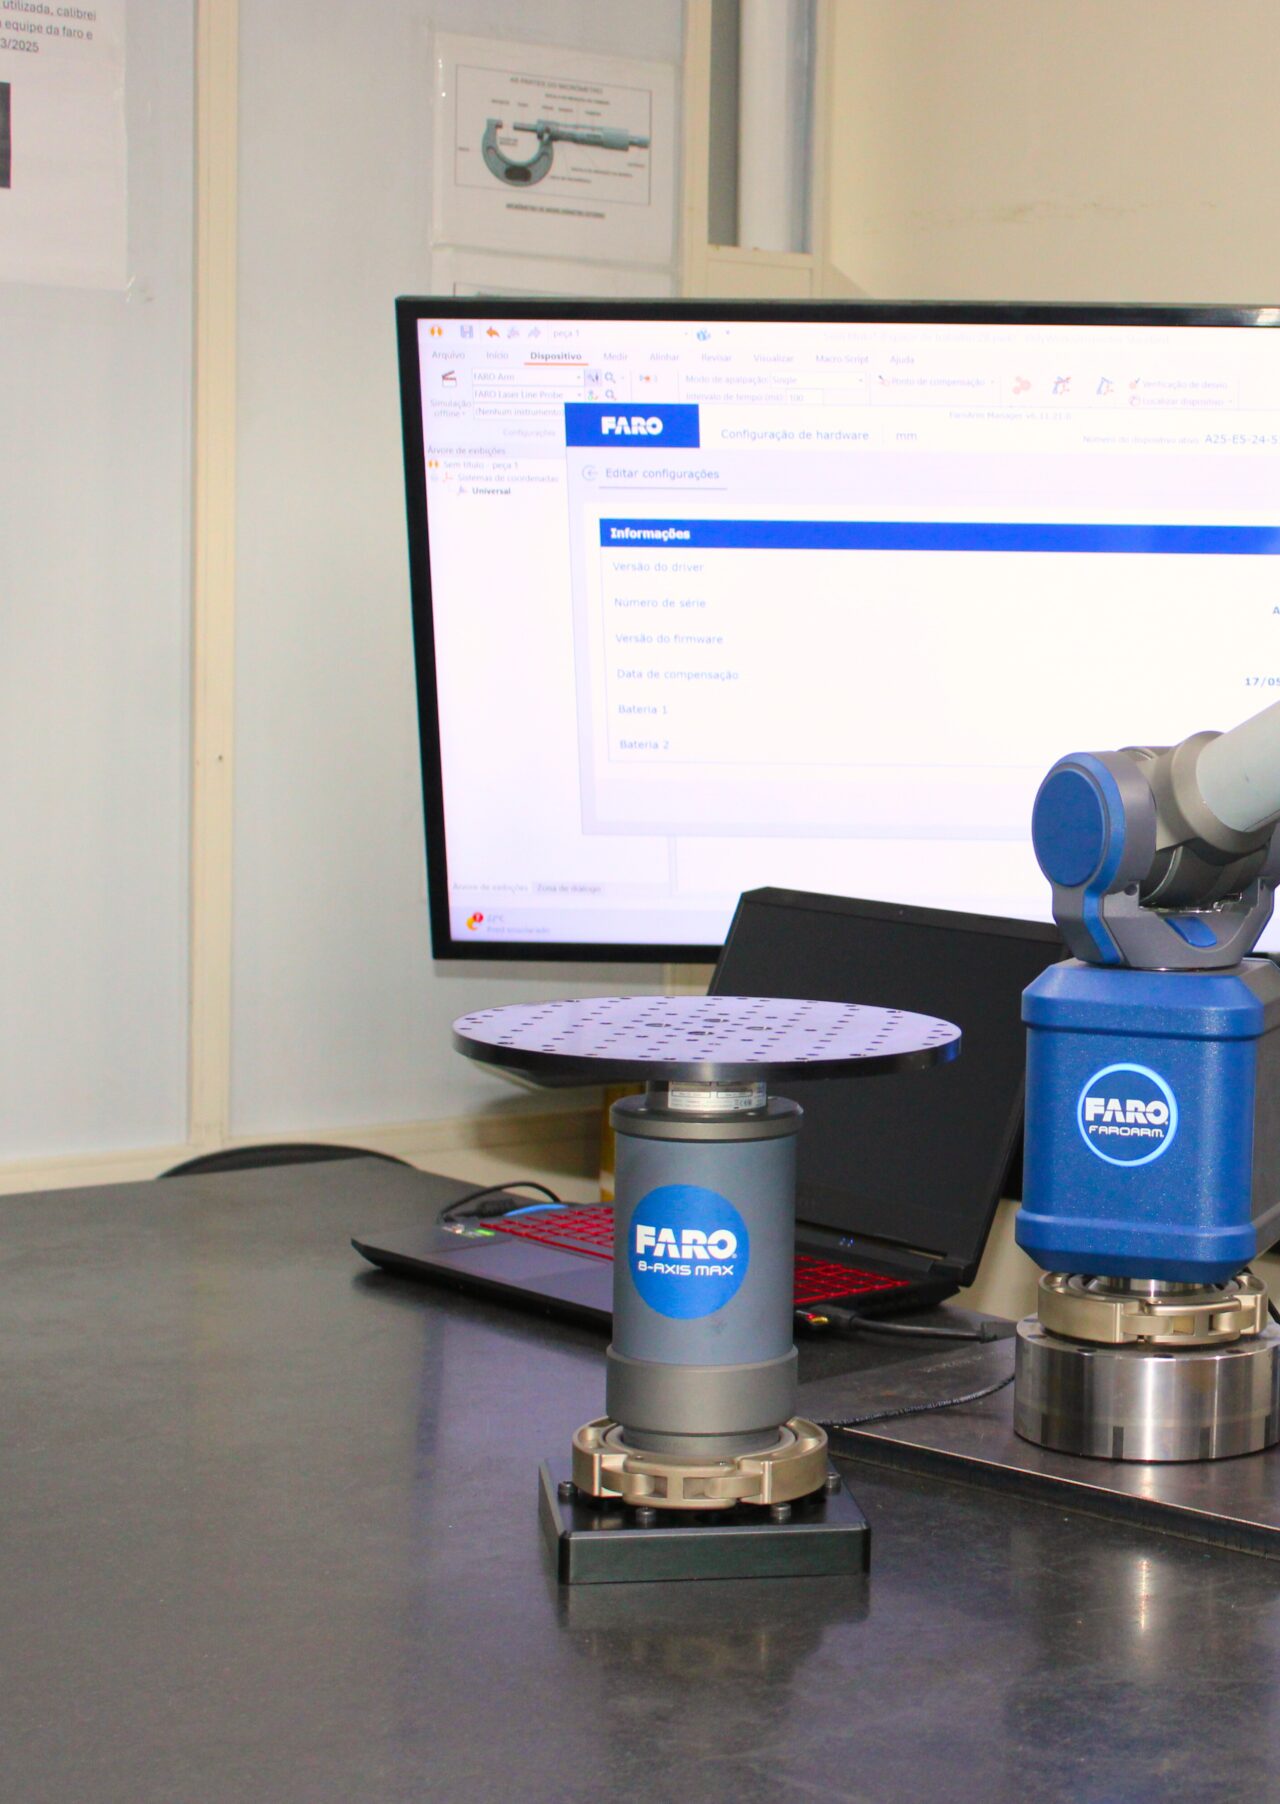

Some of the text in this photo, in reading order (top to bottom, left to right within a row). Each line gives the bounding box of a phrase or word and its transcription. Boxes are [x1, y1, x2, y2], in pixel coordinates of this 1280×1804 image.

[57, 6, 97, 21] calibrei
[4, 19, 93, 40] equipe da faro e
[431, 351, 466, 361] Arquivo
[530, 351, 582, 362] Dispositivo
[603, 352, 628, 361] Medir
[890, 355, 915, 366] Ajuda
[601, 416, 663, 436] FARO
[721, 428, 918, 442] Configuração de hardware mm
[605, 467, 720, 482] Editar configurações
[472, 487, 512, 496] Universal
[610, 527, 691, 541] Informações
[612, 560, 704, 573] Versão do driver
[614, 596, 706, 610] Número de série
[615, 632, 723, 645] Versão do firmware
[616, 668, 739, 682] Data de compensação
[618, 704, 669, 715] Bateria 1
[619, 739, 670, 751] Bateria 2
[1085, 1096, 1169, 1126] FARO
[636, 1223, 738, 1261] FARO
[638, 1262, 734, 1277] 8-AXIS MAX
